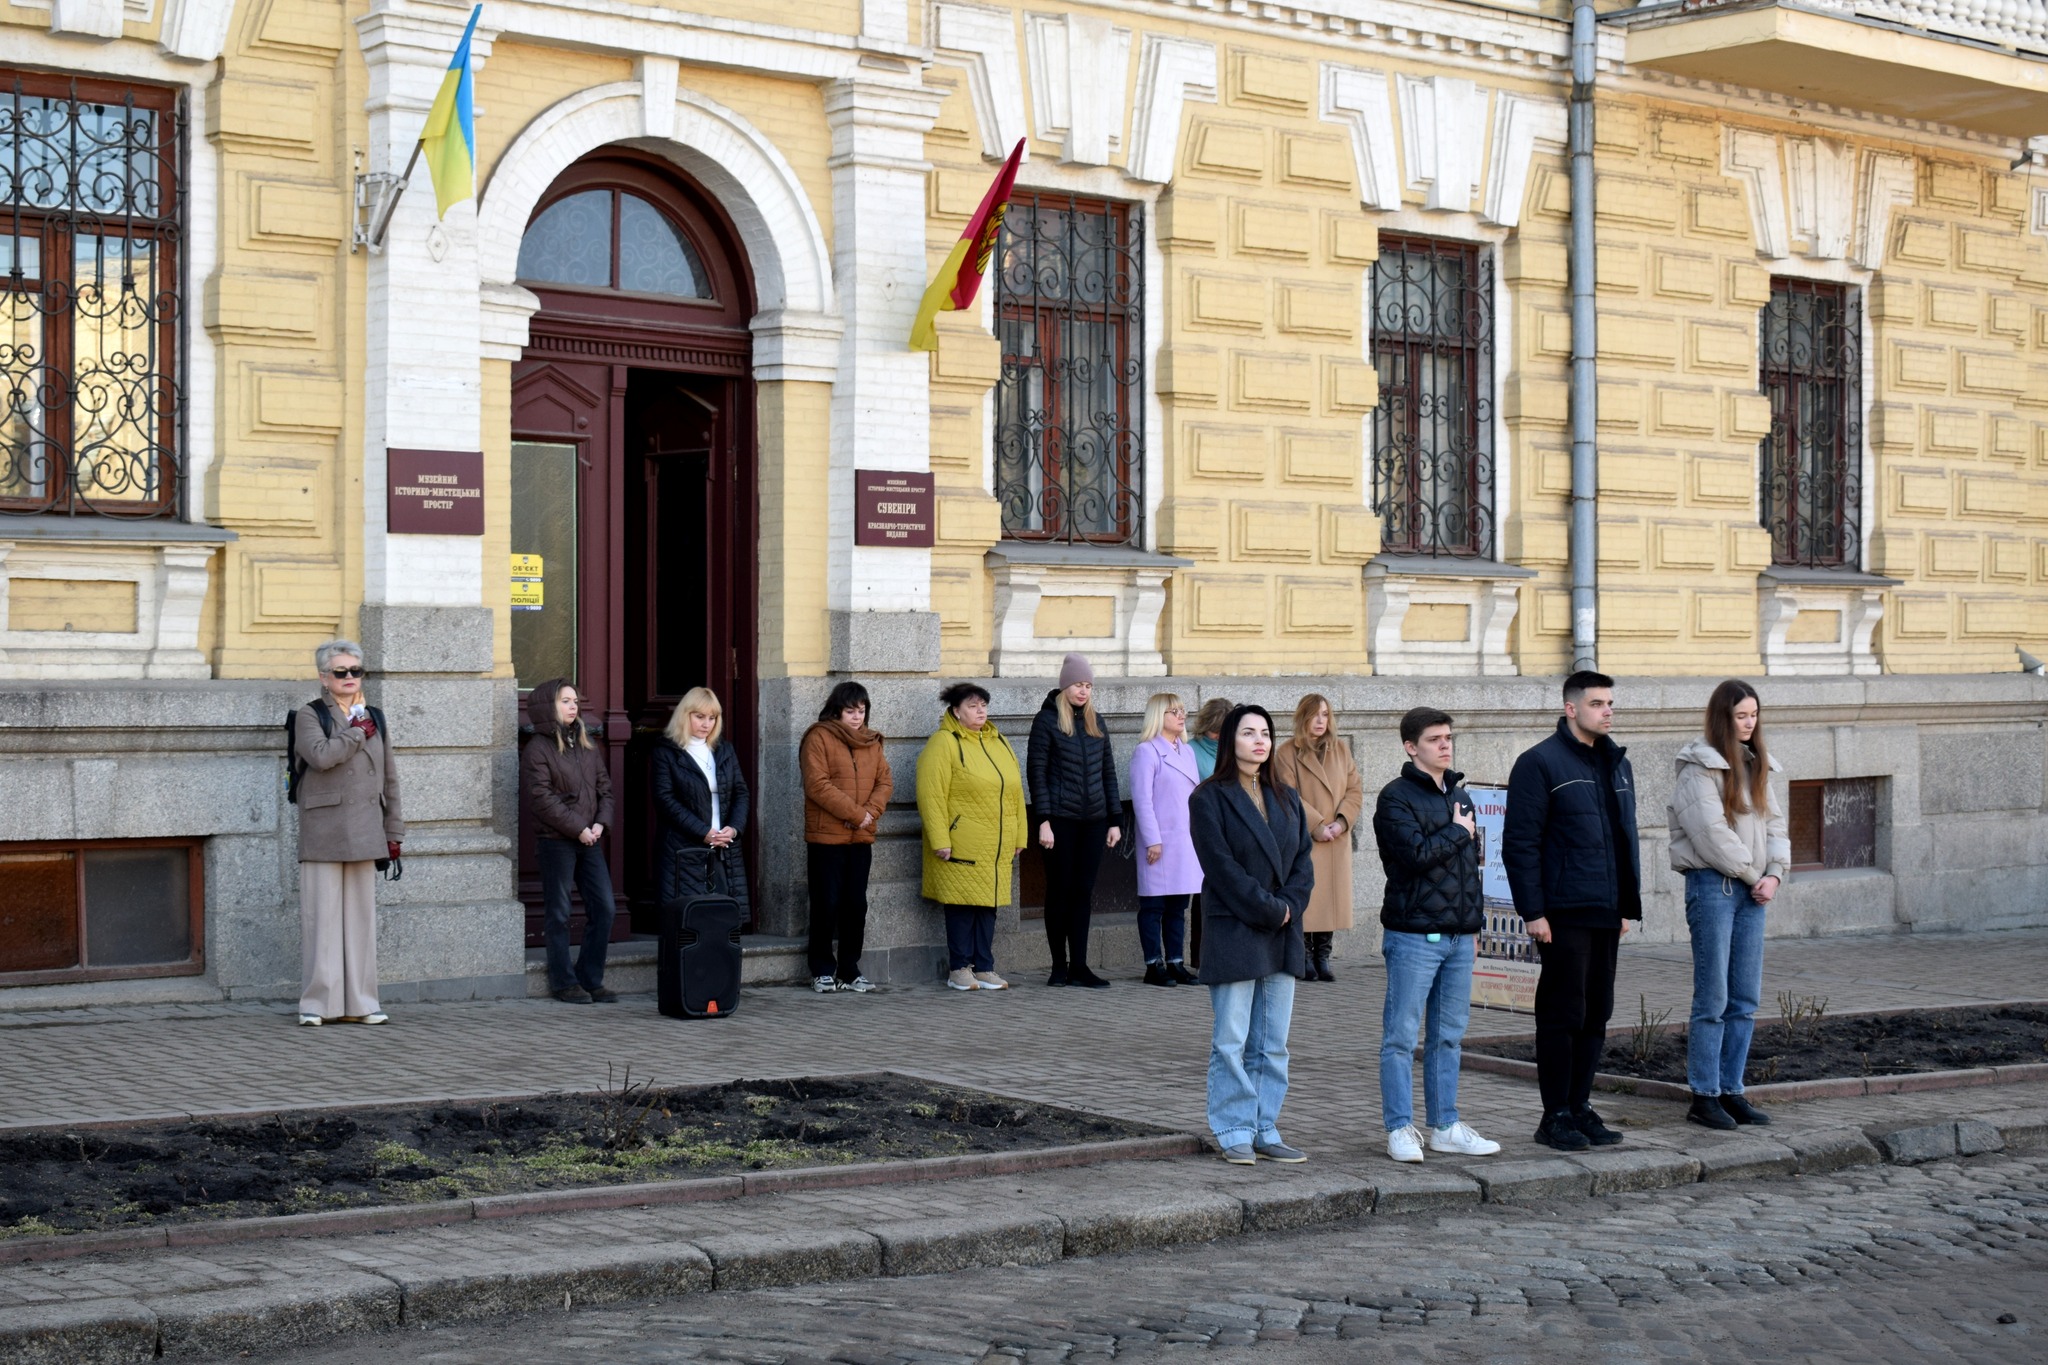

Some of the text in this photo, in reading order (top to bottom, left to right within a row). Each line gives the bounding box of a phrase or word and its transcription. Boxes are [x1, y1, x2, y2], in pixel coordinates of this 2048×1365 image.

[418, 474, 458, 485] МУЗЕЙНИЙ
[395, 486, 481, 498] ІСТОРИКО-МИСТЕЦЬКИЙ
[423, 500, 454, 509] ПРОСТІР
[878, 502, 916, 514] СУВЕНІРИ
